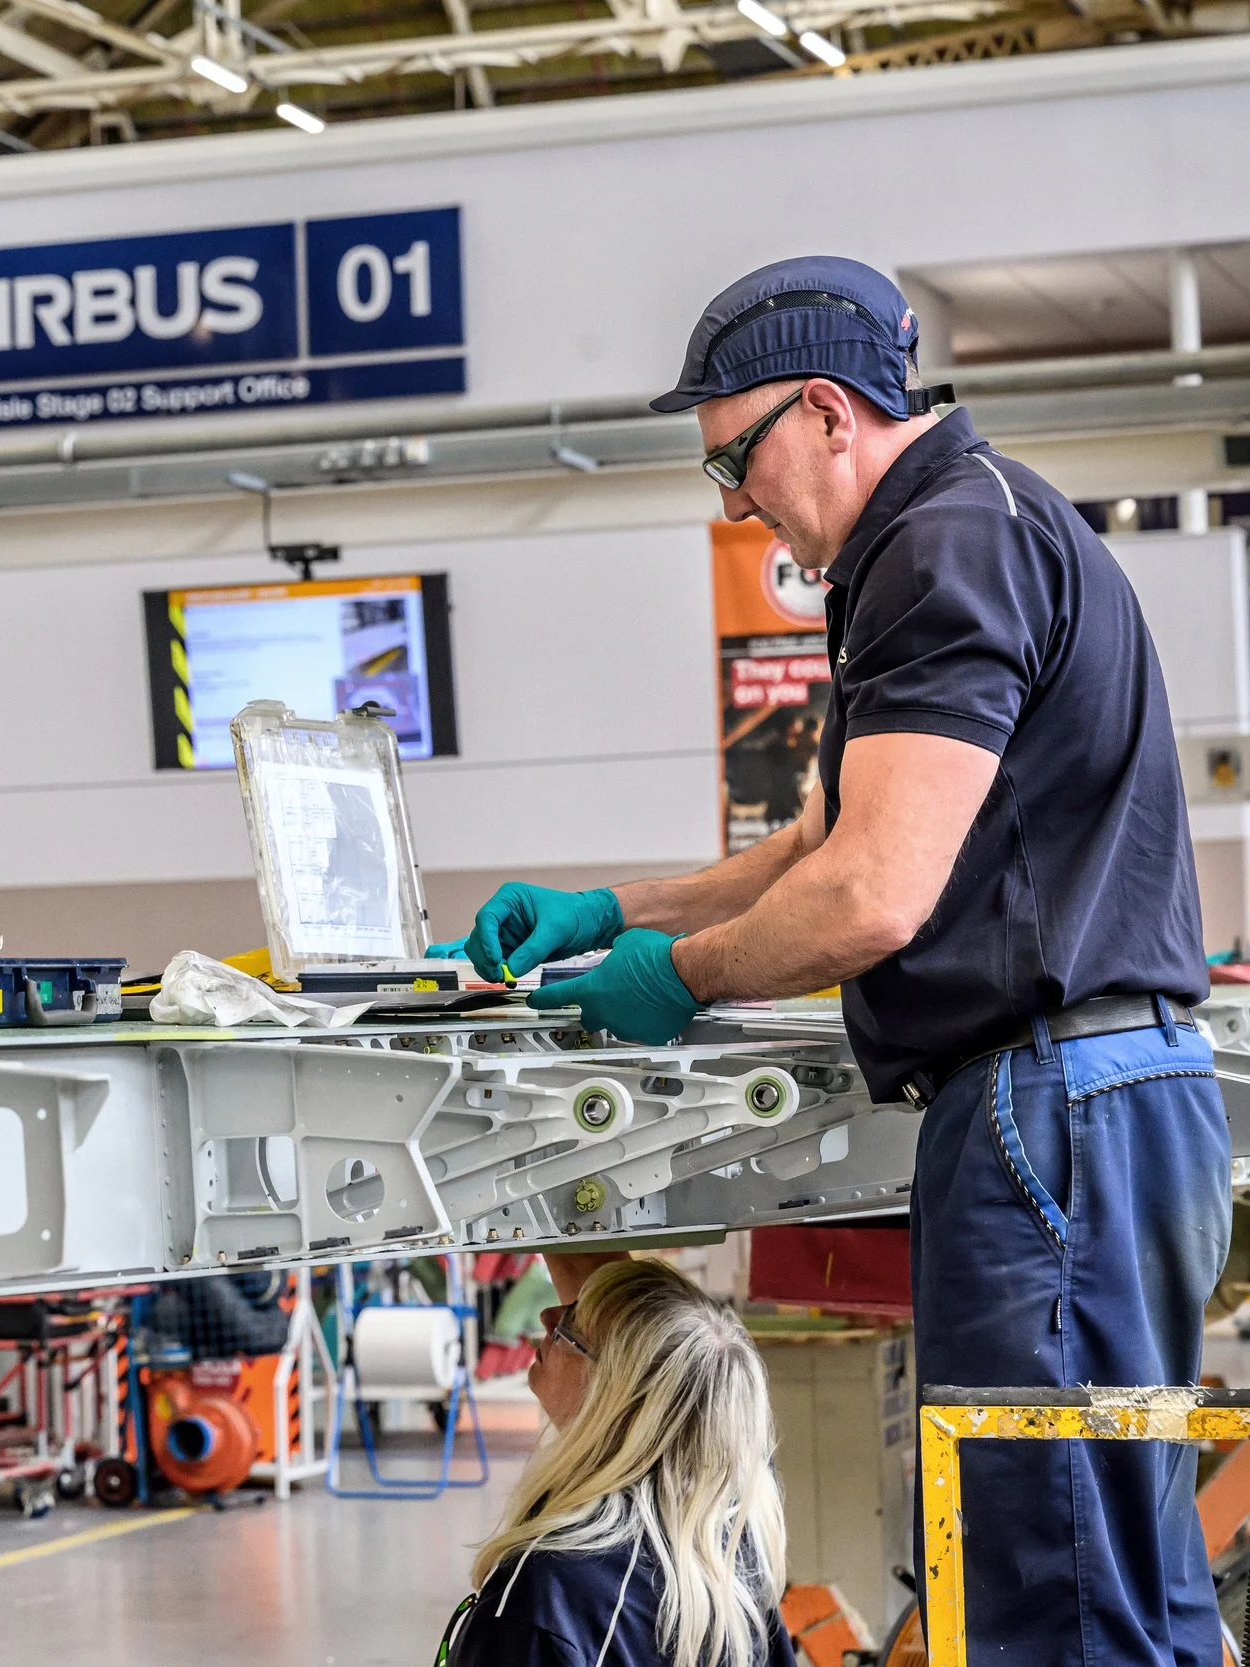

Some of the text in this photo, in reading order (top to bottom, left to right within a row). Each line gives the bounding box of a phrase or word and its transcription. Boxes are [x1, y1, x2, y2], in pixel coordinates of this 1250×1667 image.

[337, 240, 432, 323] 01
[35, 391, 105, 422] Stage
[106, 386, 138, 414] 02
[140, 379, 236, 415] Support
[238, 374, 311, 403] Office
[732, 658, 786, 684] They
[734, 681, 808, 706] on you
